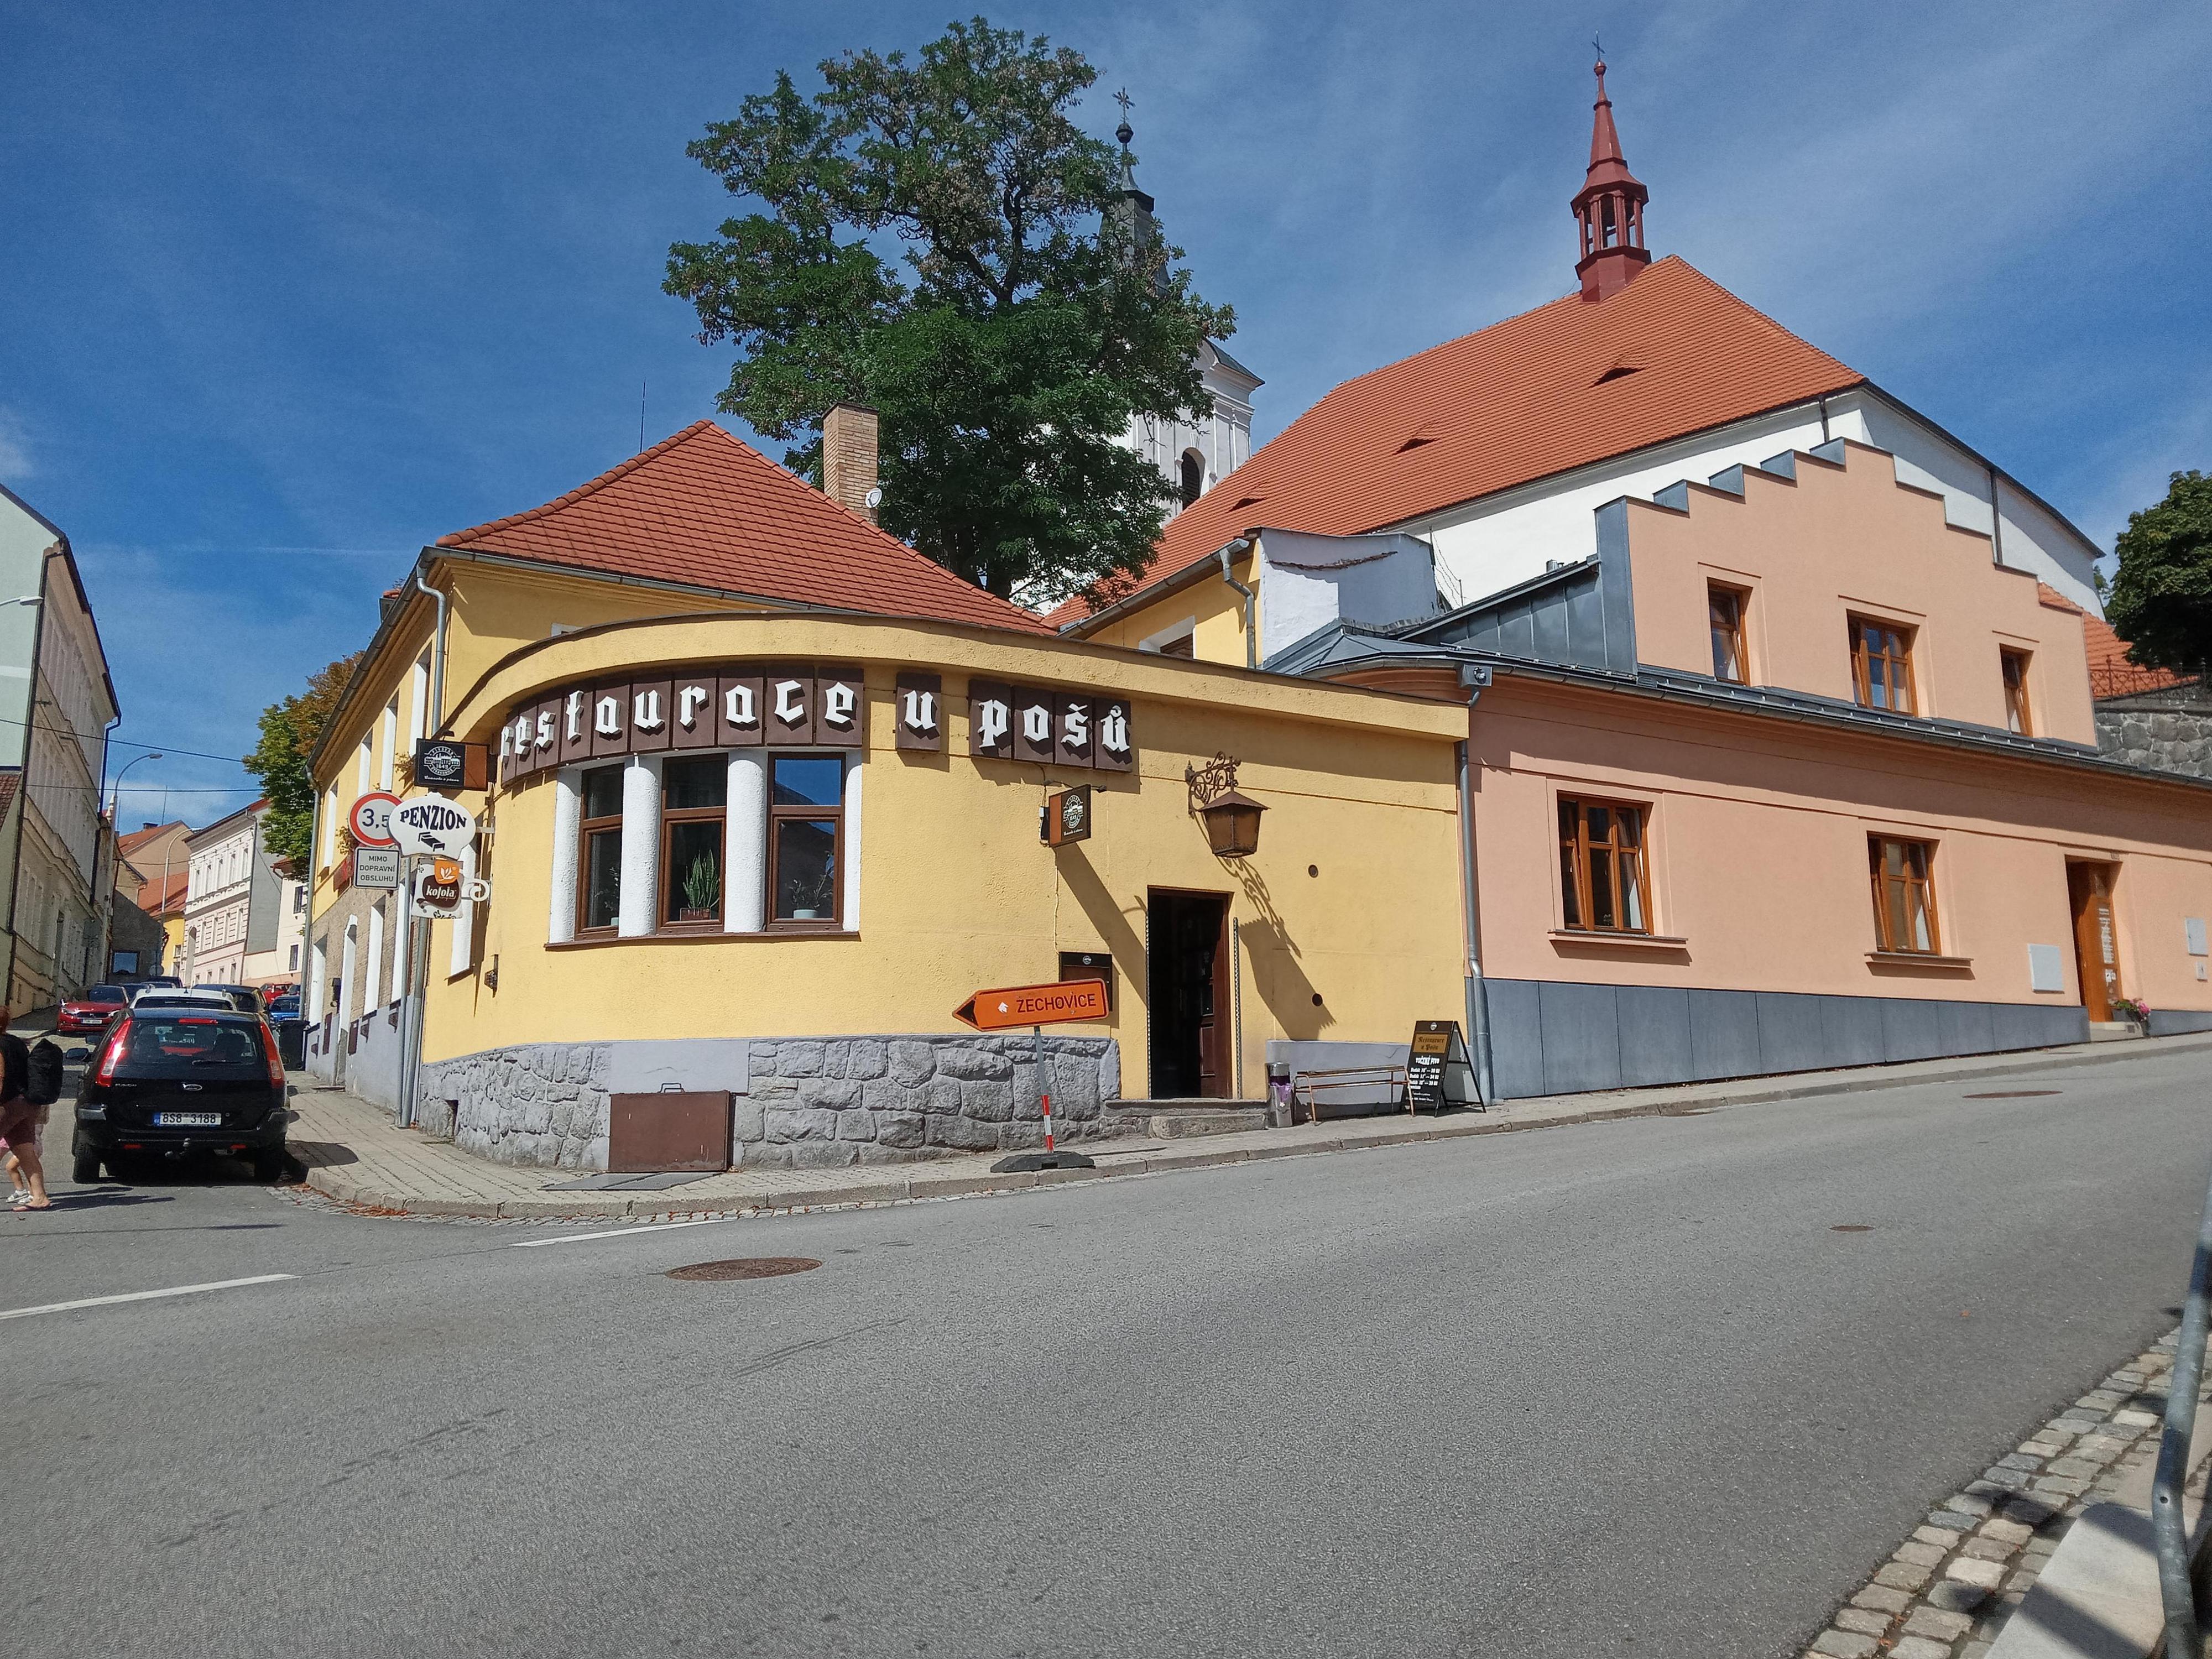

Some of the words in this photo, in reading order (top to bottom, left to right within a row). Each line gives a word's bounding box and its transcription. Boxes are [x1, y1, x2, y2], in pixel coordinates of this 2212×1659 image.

[904, 690, 936, 730] u
[400, 805, 467, 830] PENZION
[426, 885, 455, 899] kofola
[1016, 993, 1097, 1014] ZECHOVICE
[163, 1113, 182, 1123] 8S8
[190, 1113, 216, 1123] 3188
